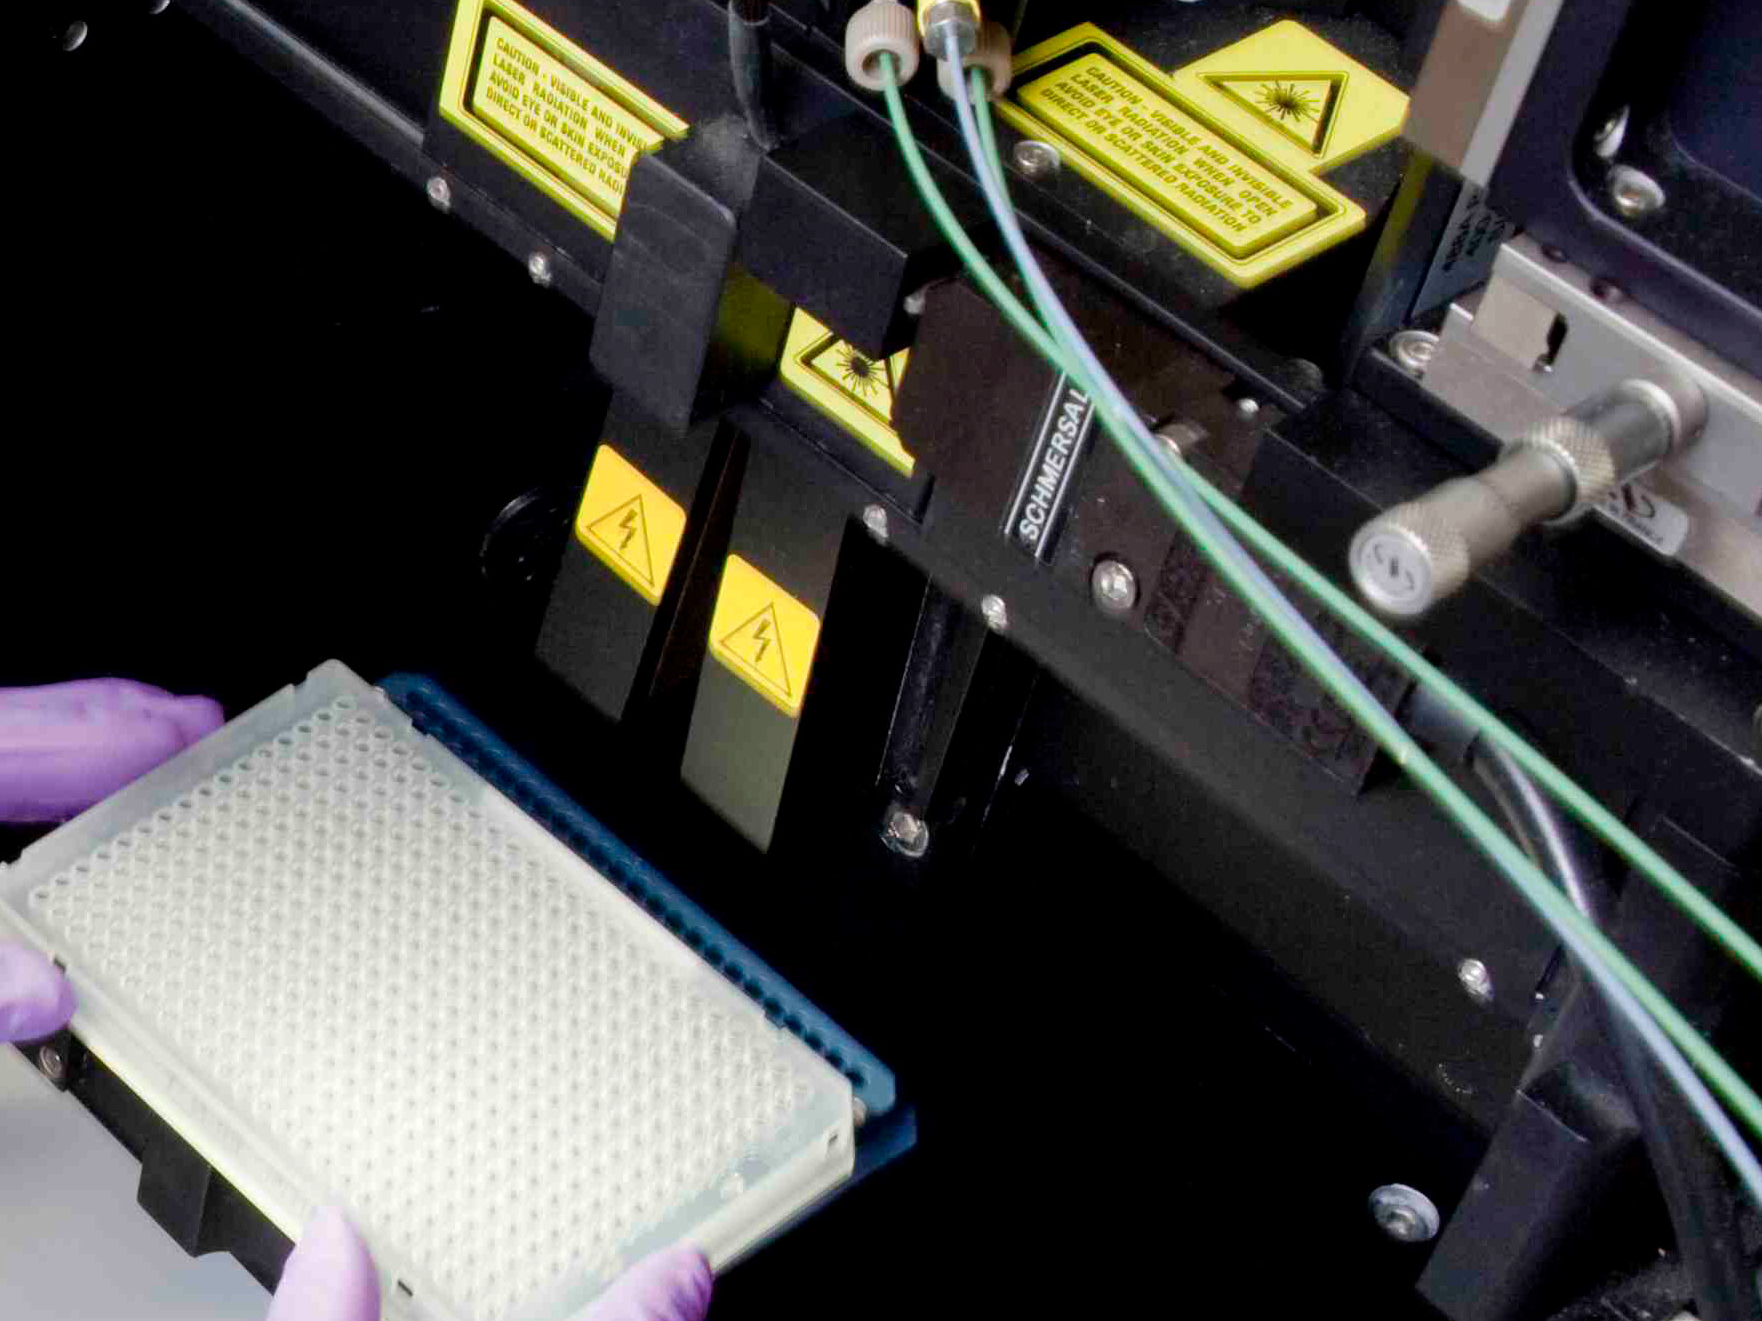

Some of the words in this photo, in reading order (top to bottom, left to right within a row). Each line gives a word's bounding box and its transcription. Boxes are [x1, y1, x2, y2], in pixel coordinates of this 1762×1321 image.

[486, 85, 521, 119] DIRECT
[523, 116, 537, 131] OR
[539, 128, 597, 175] SCATTERED
[490, 69, 520, 99] AVOID
[522, 93, 542, 116] EYE
[544, 109, 558, 127] OR
[561, 121, 585, 149] SKIN
[587, 141, 628, 179] EXPOSU
[493, 53, 525, 86] LASER
[533, 81, 588, 130] RADIATION
[595, 126, 626, 158] WHEN
[496, 37, 540, 76] CAUTION
[550, 74, 589, 111] VISIBLE
[590, 105, 613, 128] AND
[1054, 81, 1096, 109] AVOID
[1094, 107, 1123, 128] EYE
[1121, 126, 1143, 142] OR
[1140, 140, 1176, 165] SKIN
[1174, 163, 1244, 211] EXPOSURE
[1241, 209, 1262, 226] TO
[1071, 74, 1114, 105] LASER
[1118, 105, 1189, 156] RADIATION
[1193, 157, 1236, 187] WHEN
[1237, 189, 1279, 218] OPEN
[1086, 66, 1144, 105] CAUTION
[1150, 109, 1202, 146] VISIBLE
[1199, 145, 1228, 166] AND
[1227, 164, 1294, 209] INVISIBLE
[1039, 88, 1088, 121] DIRECT
[1085, 119, 1107, 136] OR
[1104, 132, 1178, 185] SCATTERED
[1177, 182, 1249, 233] RADIATION
[1019, 387, 1089, 541] SCHMERSAL
